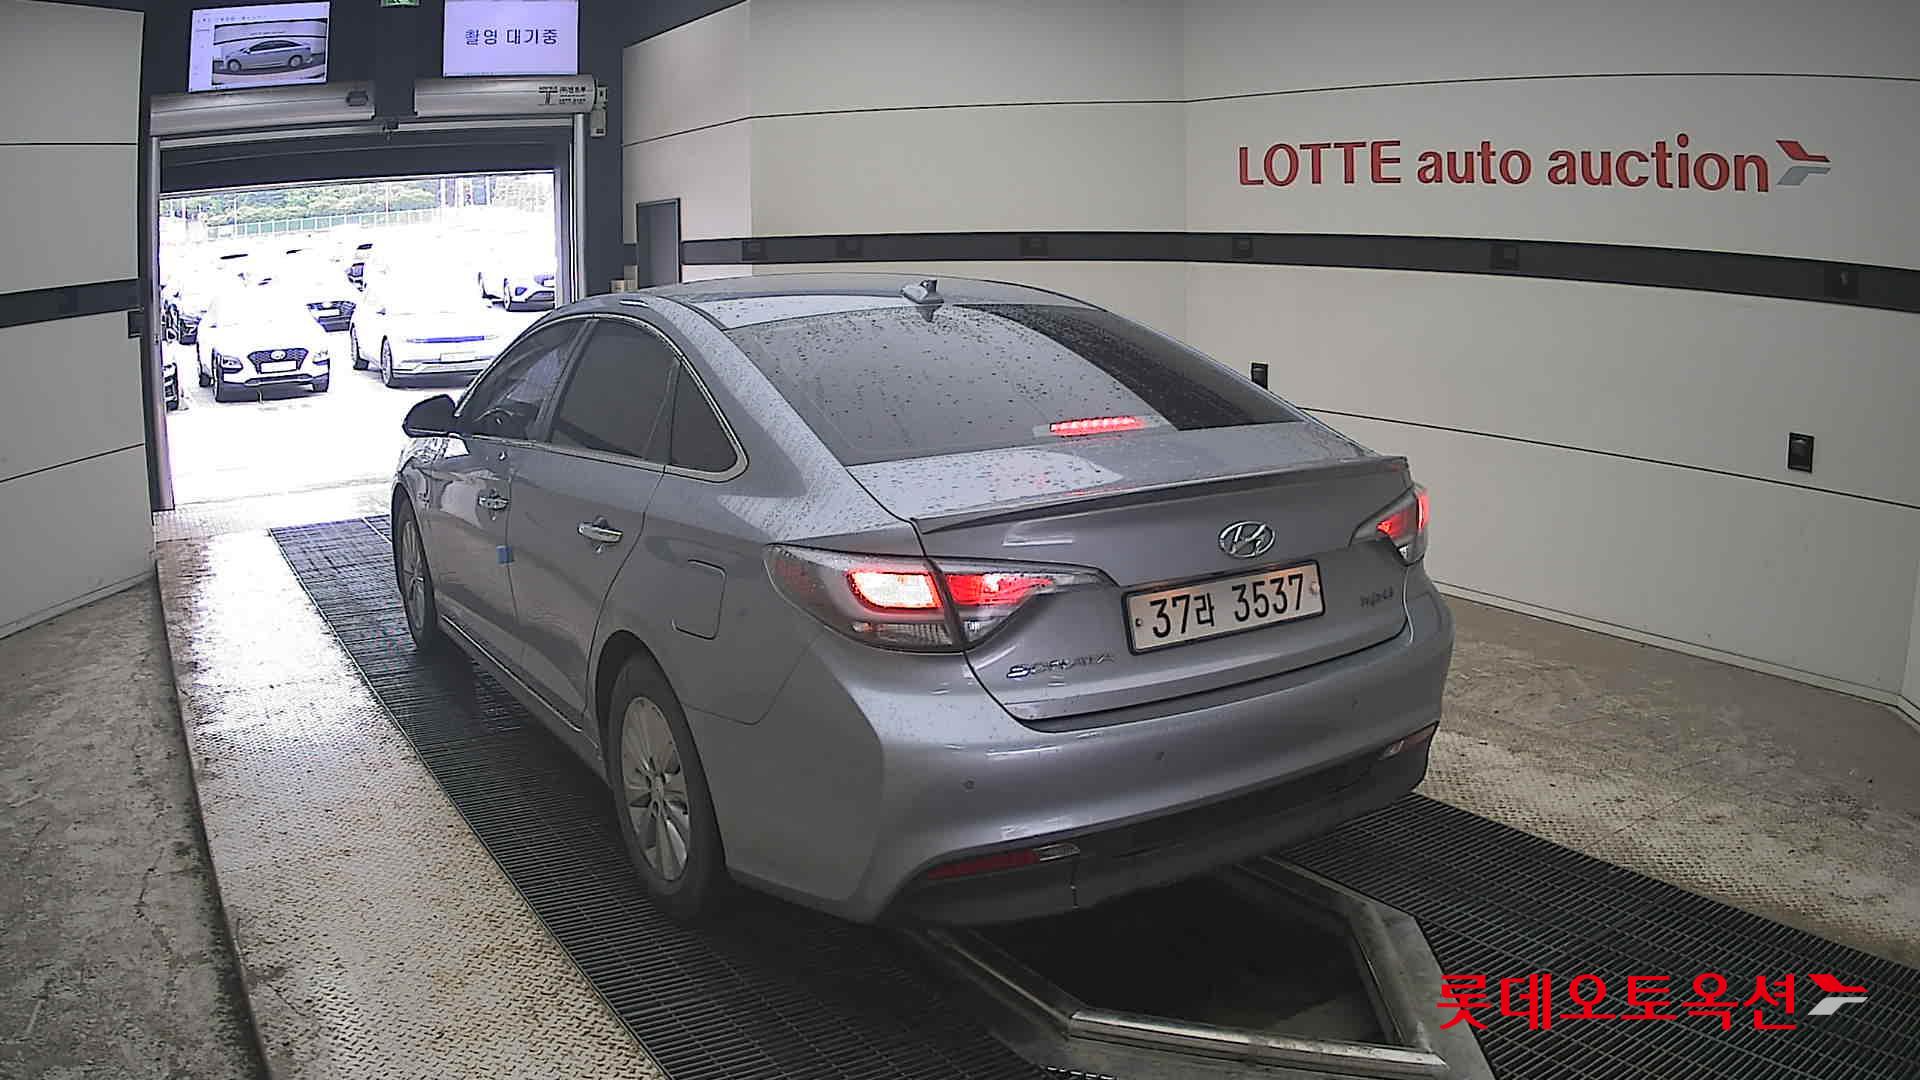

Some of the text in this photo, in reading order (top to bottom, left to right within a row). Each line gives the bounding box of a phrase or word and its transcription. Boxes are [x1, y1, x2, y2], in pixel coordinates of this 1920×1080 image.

[465, 28, 558, 46] 촬영 대기중
[1238, 133, 1768, 193] LOTTE auto auction
[1151, 594, 1215, 639] 37라
[1232, 573, 1304, 624] 3537
